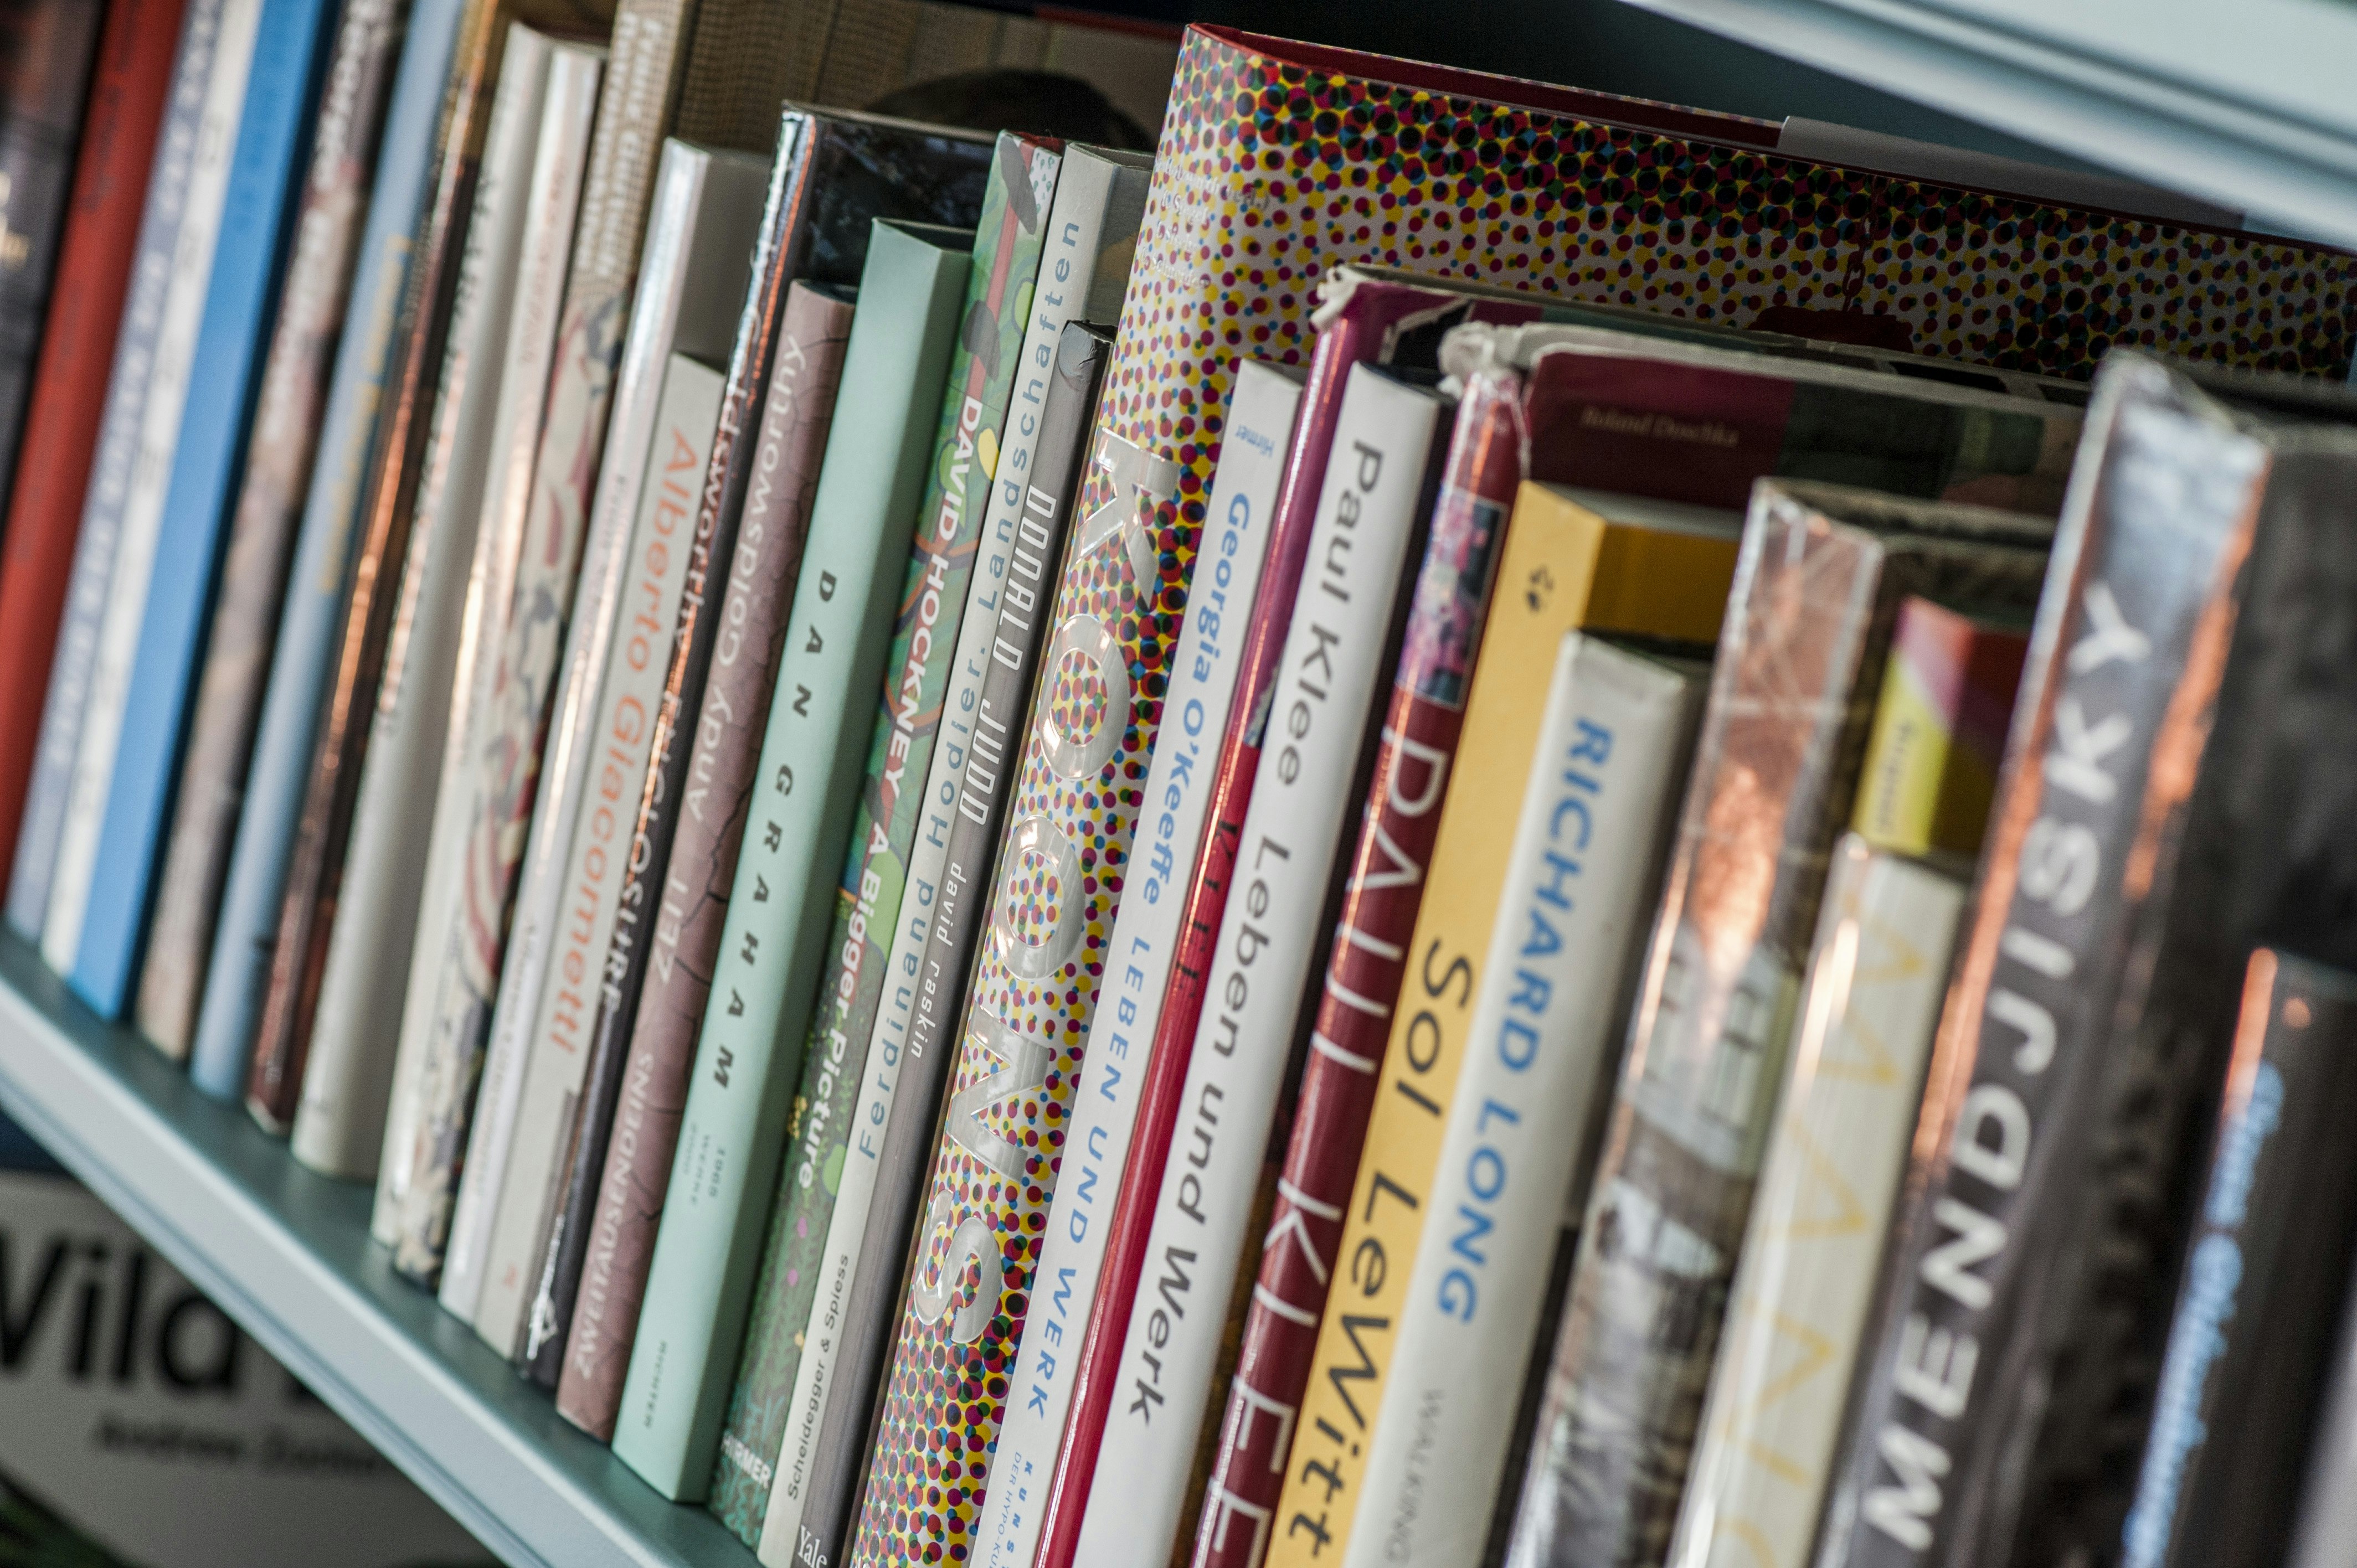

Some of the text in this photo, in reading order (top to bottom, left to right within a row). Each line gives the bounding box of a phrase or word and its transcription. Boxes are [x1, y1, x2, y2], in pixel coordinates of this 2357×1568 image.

[977, 221, 1080, 612] Landschaften
[548, 427, 698, 1052] Alberto Giacometti
[572, 334, 807, 1381] ZWEITAUSENDEINS ZEIT Andy Goldsworthy
[713, 569, 837, 1090] DAN GRAHAM
[797, 394, 982, 1190] DAVID HOCKNEY A Bigger Picture
[860, 878, 934, 1160] Ferdinand
[910, 484, 1057, 1059] DONALD JUDD david raskin
[913, 425, 1182, 1344] KOONS
[1027, 492, 1250, 1421] Georgia O'Keeffe LEBEN UND WERK
[1129, 439, 1382, 1426] Paul Klee Leben und Werk
[1437, 717, 1614, 1324] RICHARD LONG
[820, 1338, 830, 1352] &
[824, 1254, 848, 1328] Spiess
[1287, 937, 1474, 1559] Sol LeWitt
[1861, 580, 2151, 1551] MENDJISKY
[787, 1360, 825, 1500] Scheidegger
[797, 1524, 827, 1568] Yale
[989, 1452, 1022, 1568] DER HYPO-KU
[1001, 1461, 1033, 1568] KUNS
